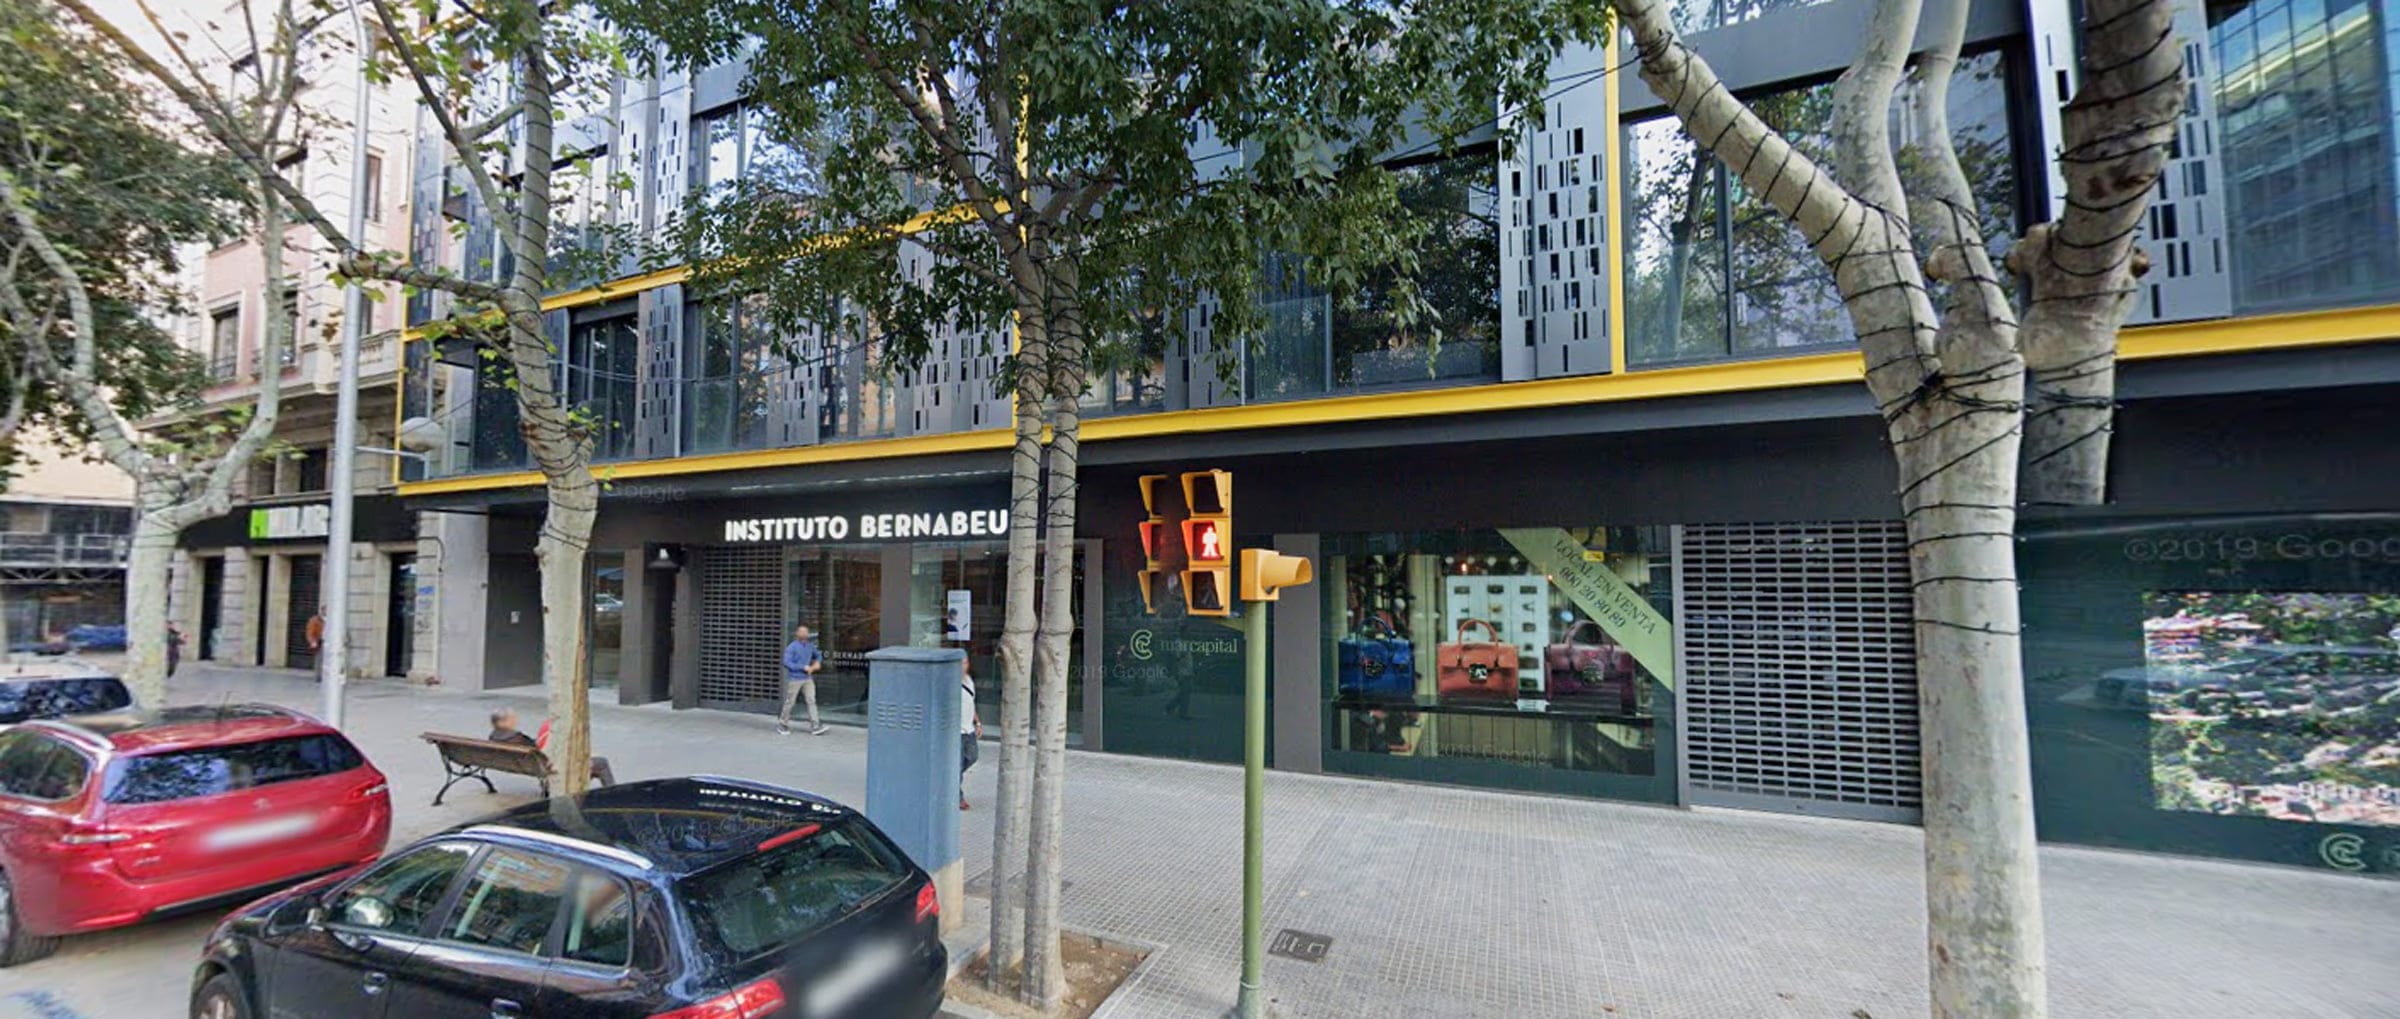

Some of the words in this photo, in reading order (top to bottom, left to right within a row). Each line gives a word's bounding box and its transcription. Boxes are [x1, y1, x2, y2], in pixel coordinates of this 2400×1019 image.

[725, 515, 849, 542] INSTITUTO
[860, 509, 1008, 538] BERNABEU
[1554, 540, 1595, 578] LOCAL
[1594, 575, 1616, 595] EN
[1613, 591, 1657, 634] VENTA
[1580, 584, 1596, 602] 20
[1159, 638, 1238, 656] marcapital
